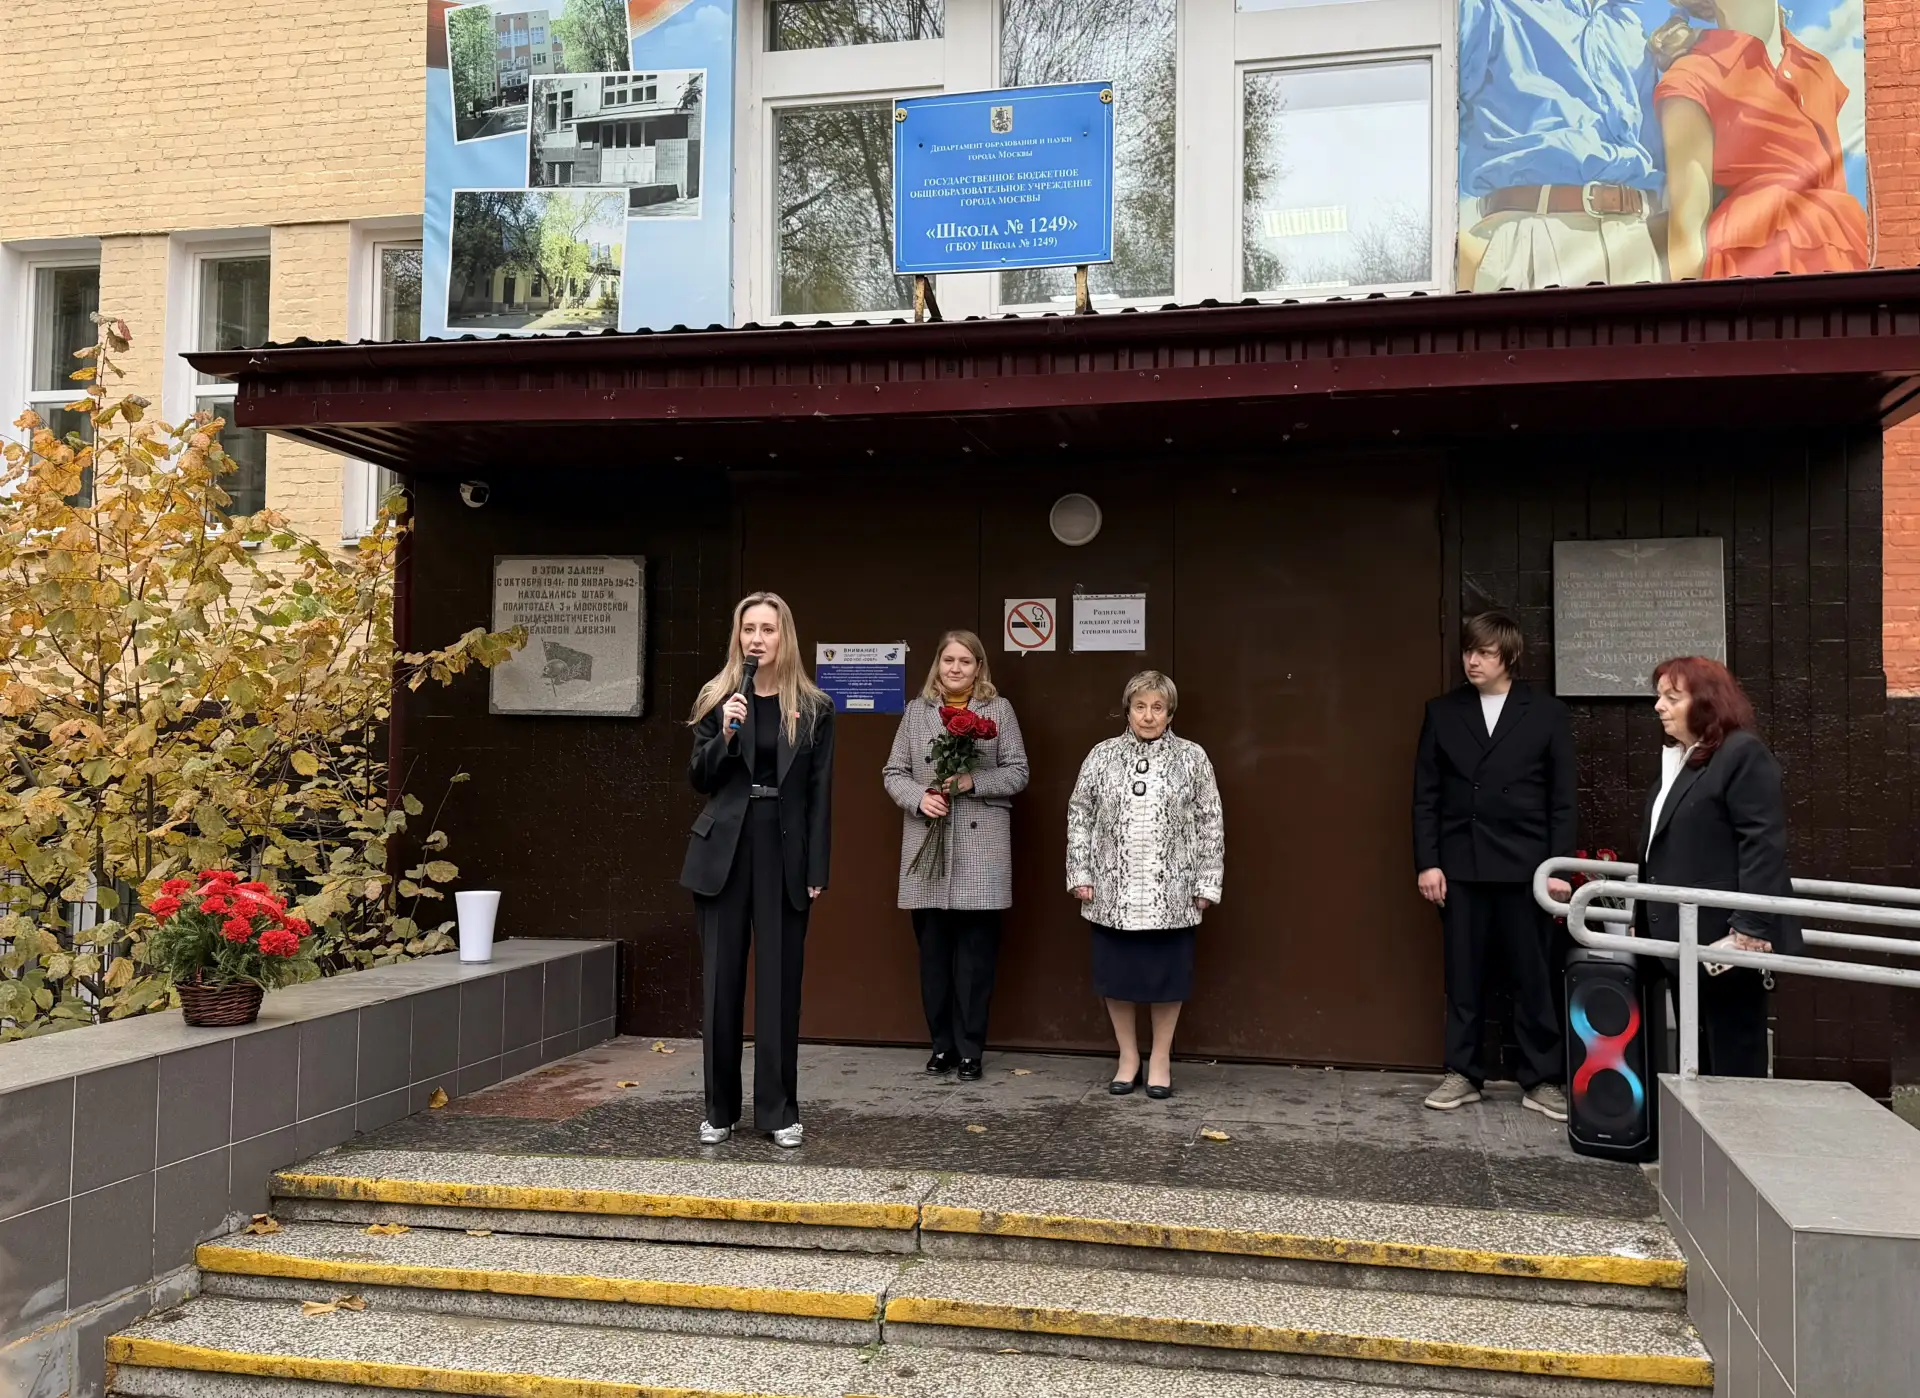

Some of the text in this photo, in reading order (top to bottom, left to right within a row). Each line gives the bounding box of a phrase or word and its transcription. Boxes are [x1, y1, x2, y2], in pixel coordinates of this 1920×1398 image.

[924, 168, 1079, 187] ГОСУДАРСТВЕННОЕ БЮДЖЕТНОЕ
[910, 179, 1093, 199] ОБЩЕОБРАЗОВАТЕЛЬНОЕ УЧРЕЖДЕНИЕ
[960, 194, 1041, 207] ГОРОДА МОСКВЫ
[1004, 218, 1024, 235] №
[1030, 215, 1078, 233] 1249»
[945, 241, 978, 253] (ГБОУ
[1019, 238, 1030, 249] №
[1033, 236, 1058, 248] 1249)
[531, 565, 605, 575] В ЭТОМ ЗДАНИИ
[496, 577, 502, 587] С
[504, 577, 542, 587] ОКТЯБРЯ
[567, 577, 579, 587] ПО
[581, 577, 614, 587] ЯНВАРЬ
[518, 590, 614, 599] НАХОДИЛИСЬ ШТАБ И
[503, 602, 555, 611] ПОЛИТОТДЕЛ
[573, 601, 628, 611] МОСКОВСКОЙ
[575, 625, 616, 635] ДИВИЗИИ
